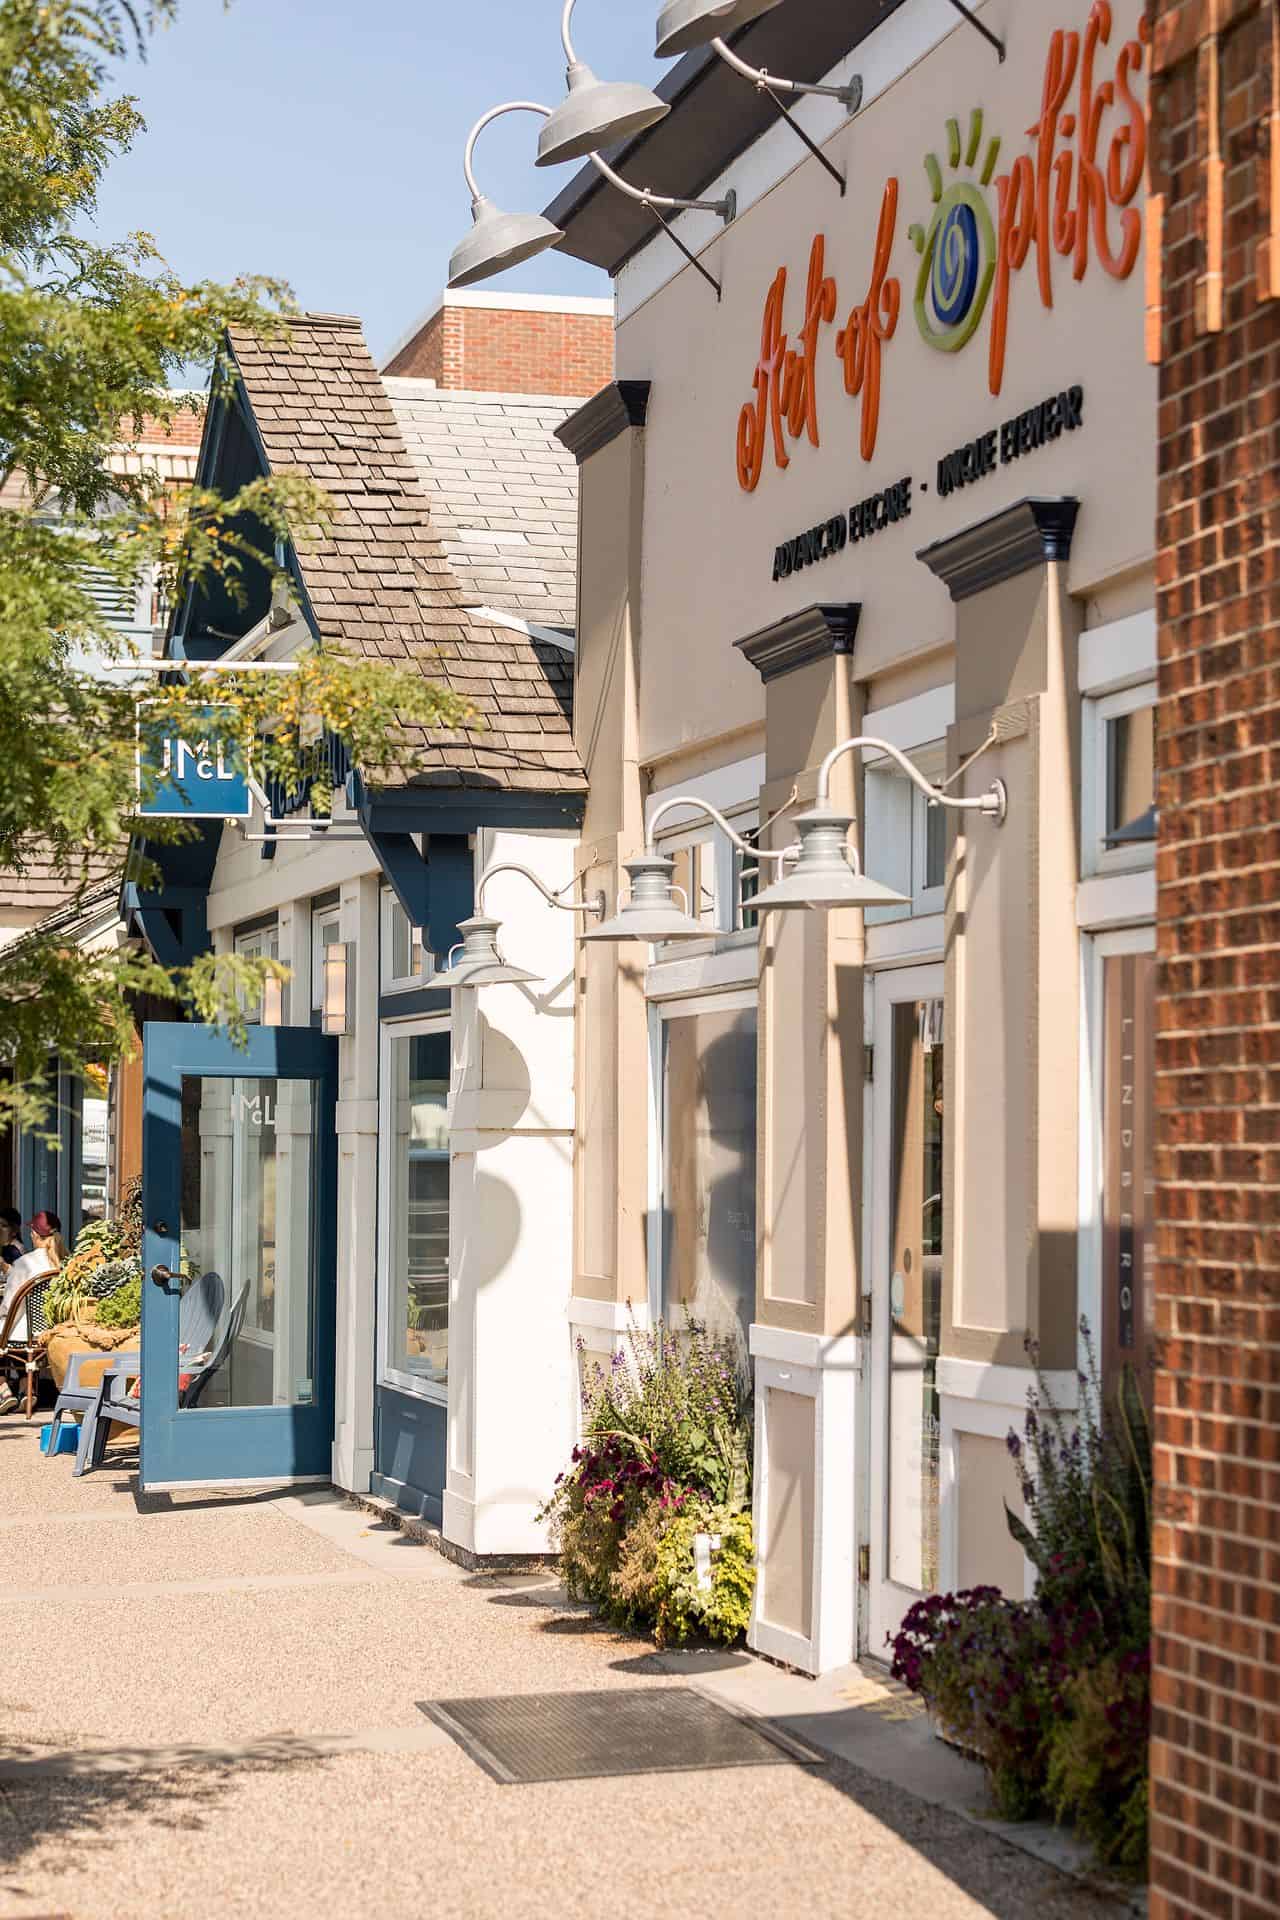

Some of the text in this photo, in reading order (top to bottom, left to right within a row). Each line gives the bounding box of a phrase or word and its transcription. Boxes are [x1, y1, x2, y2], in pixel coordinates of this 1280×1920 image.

[736, 233, 837, 493] Art
[836, 177, 901, 462] of
[772, 385, 1084, 582] ADVANCED EYECARE UNIQUE EYEWEAR
